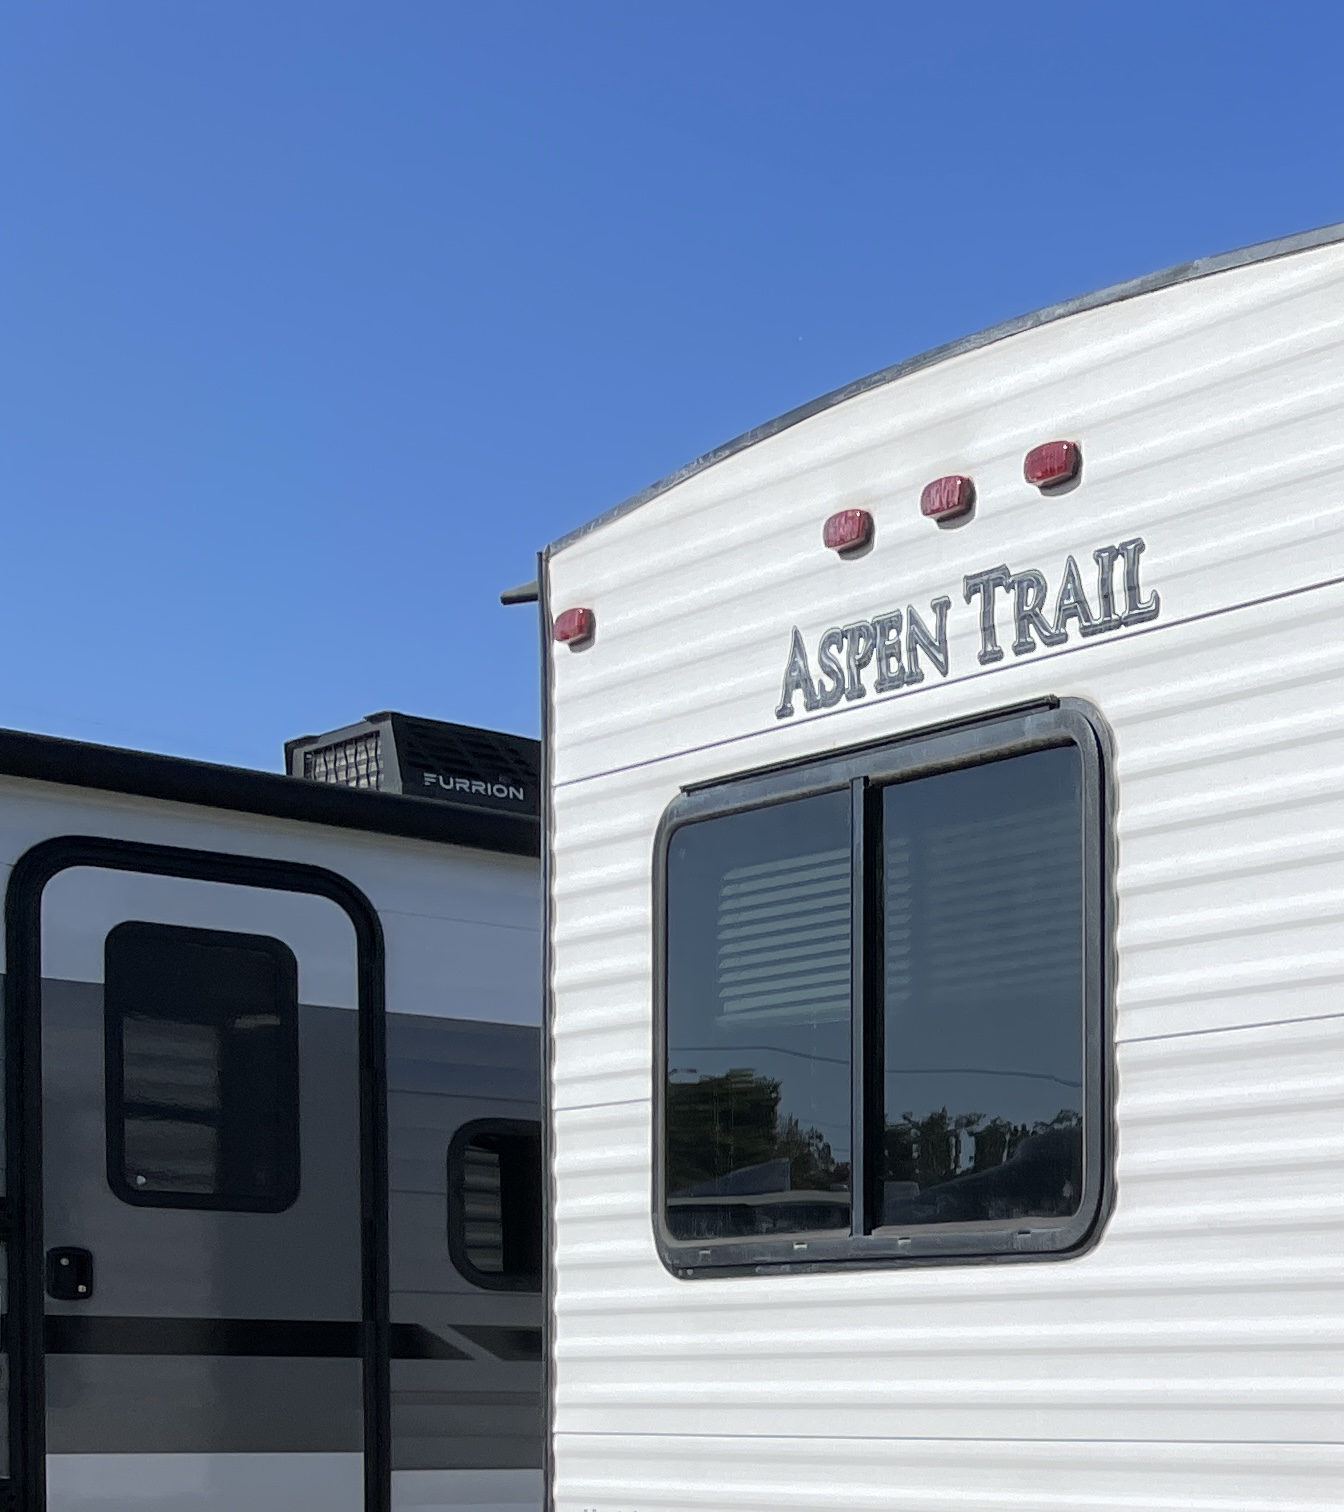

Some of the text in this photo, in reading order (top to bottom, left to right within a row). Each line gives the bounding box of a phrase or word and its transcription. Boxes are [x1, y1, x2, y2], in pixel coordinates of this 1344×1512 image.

[774, 537, 1161, 719] ASPEN TRAIL
[423, 772, 524, 800] FURRION
